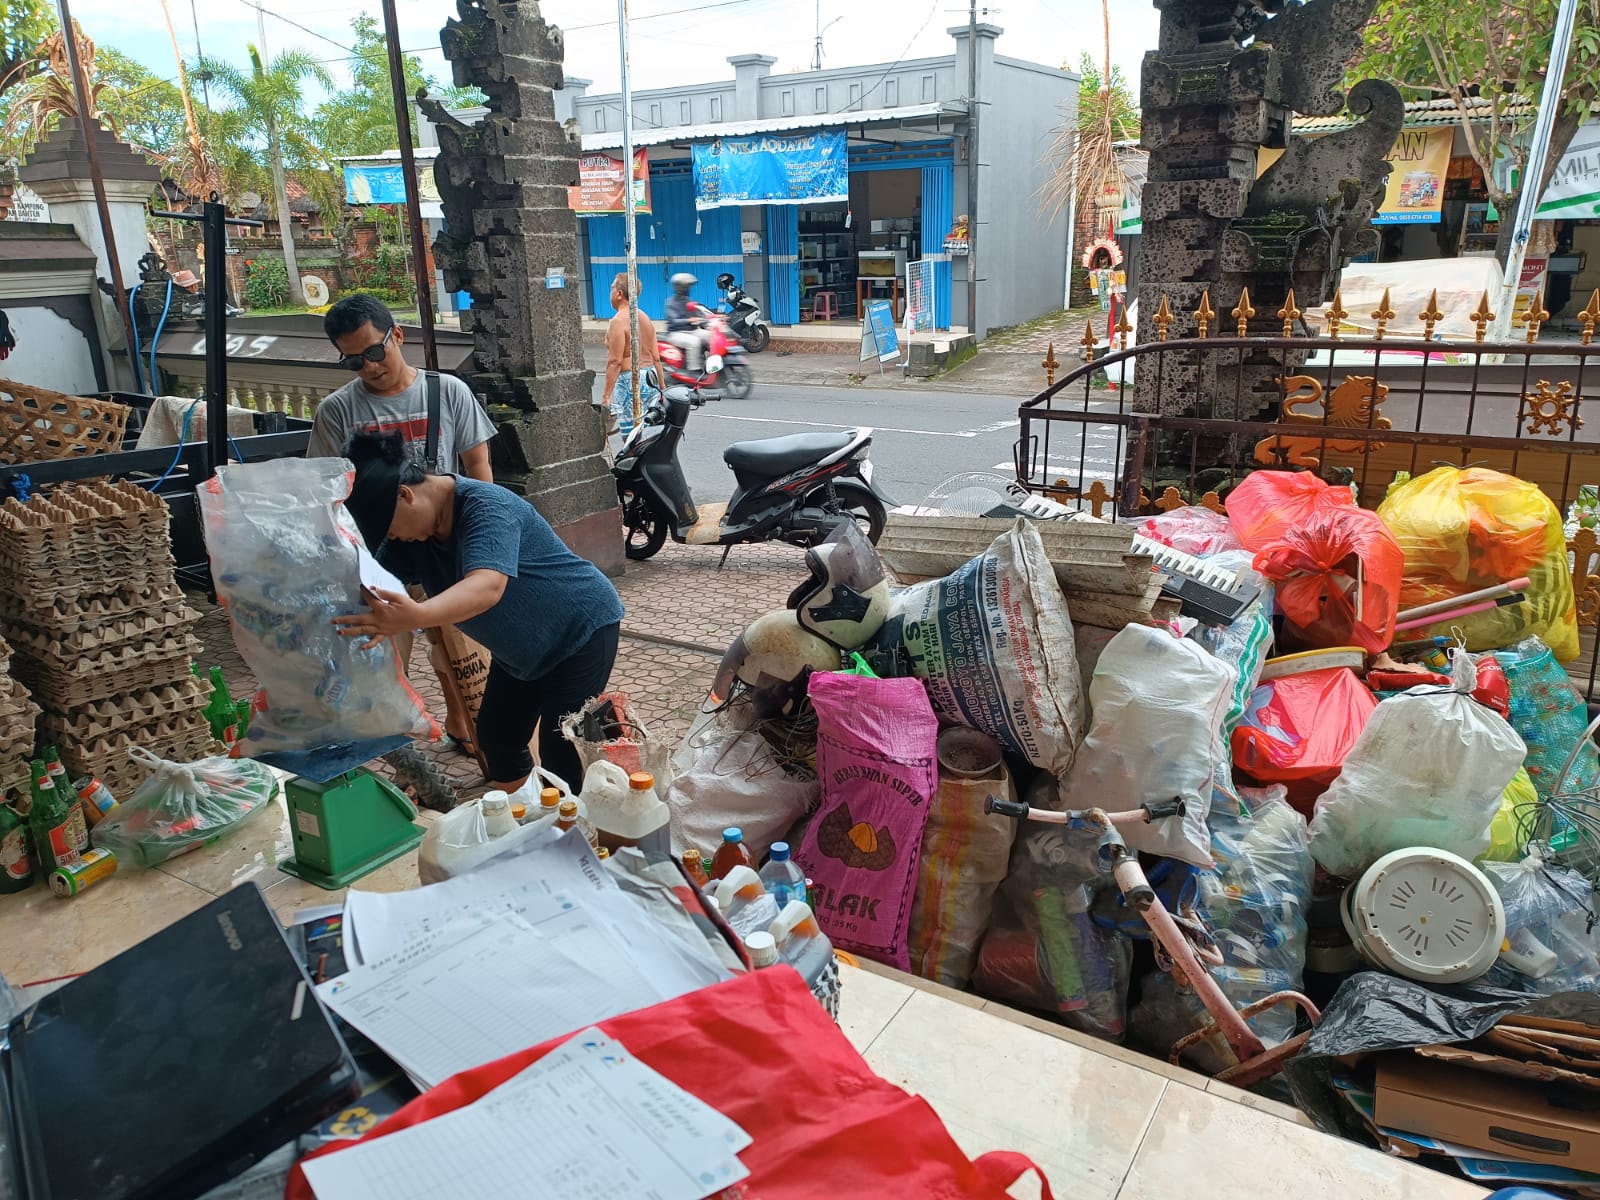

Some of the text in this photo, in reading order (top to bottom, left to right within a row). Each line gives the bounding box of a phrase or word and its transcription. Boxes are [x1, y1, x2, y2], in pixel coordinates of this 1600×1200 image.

[760, 136, 815, 153] AQUATIC
[1381, 132, 1428, 161] AN
[946, 610, 965, 654] JAYA
[991, 613, 1003, 628] No.
[923, 636, 933, 657] AYAM
[929, 623, 939, 647] HARI
[890, 778, 924, 807] SUPER
[216, 910, 243, 950] lenovo
